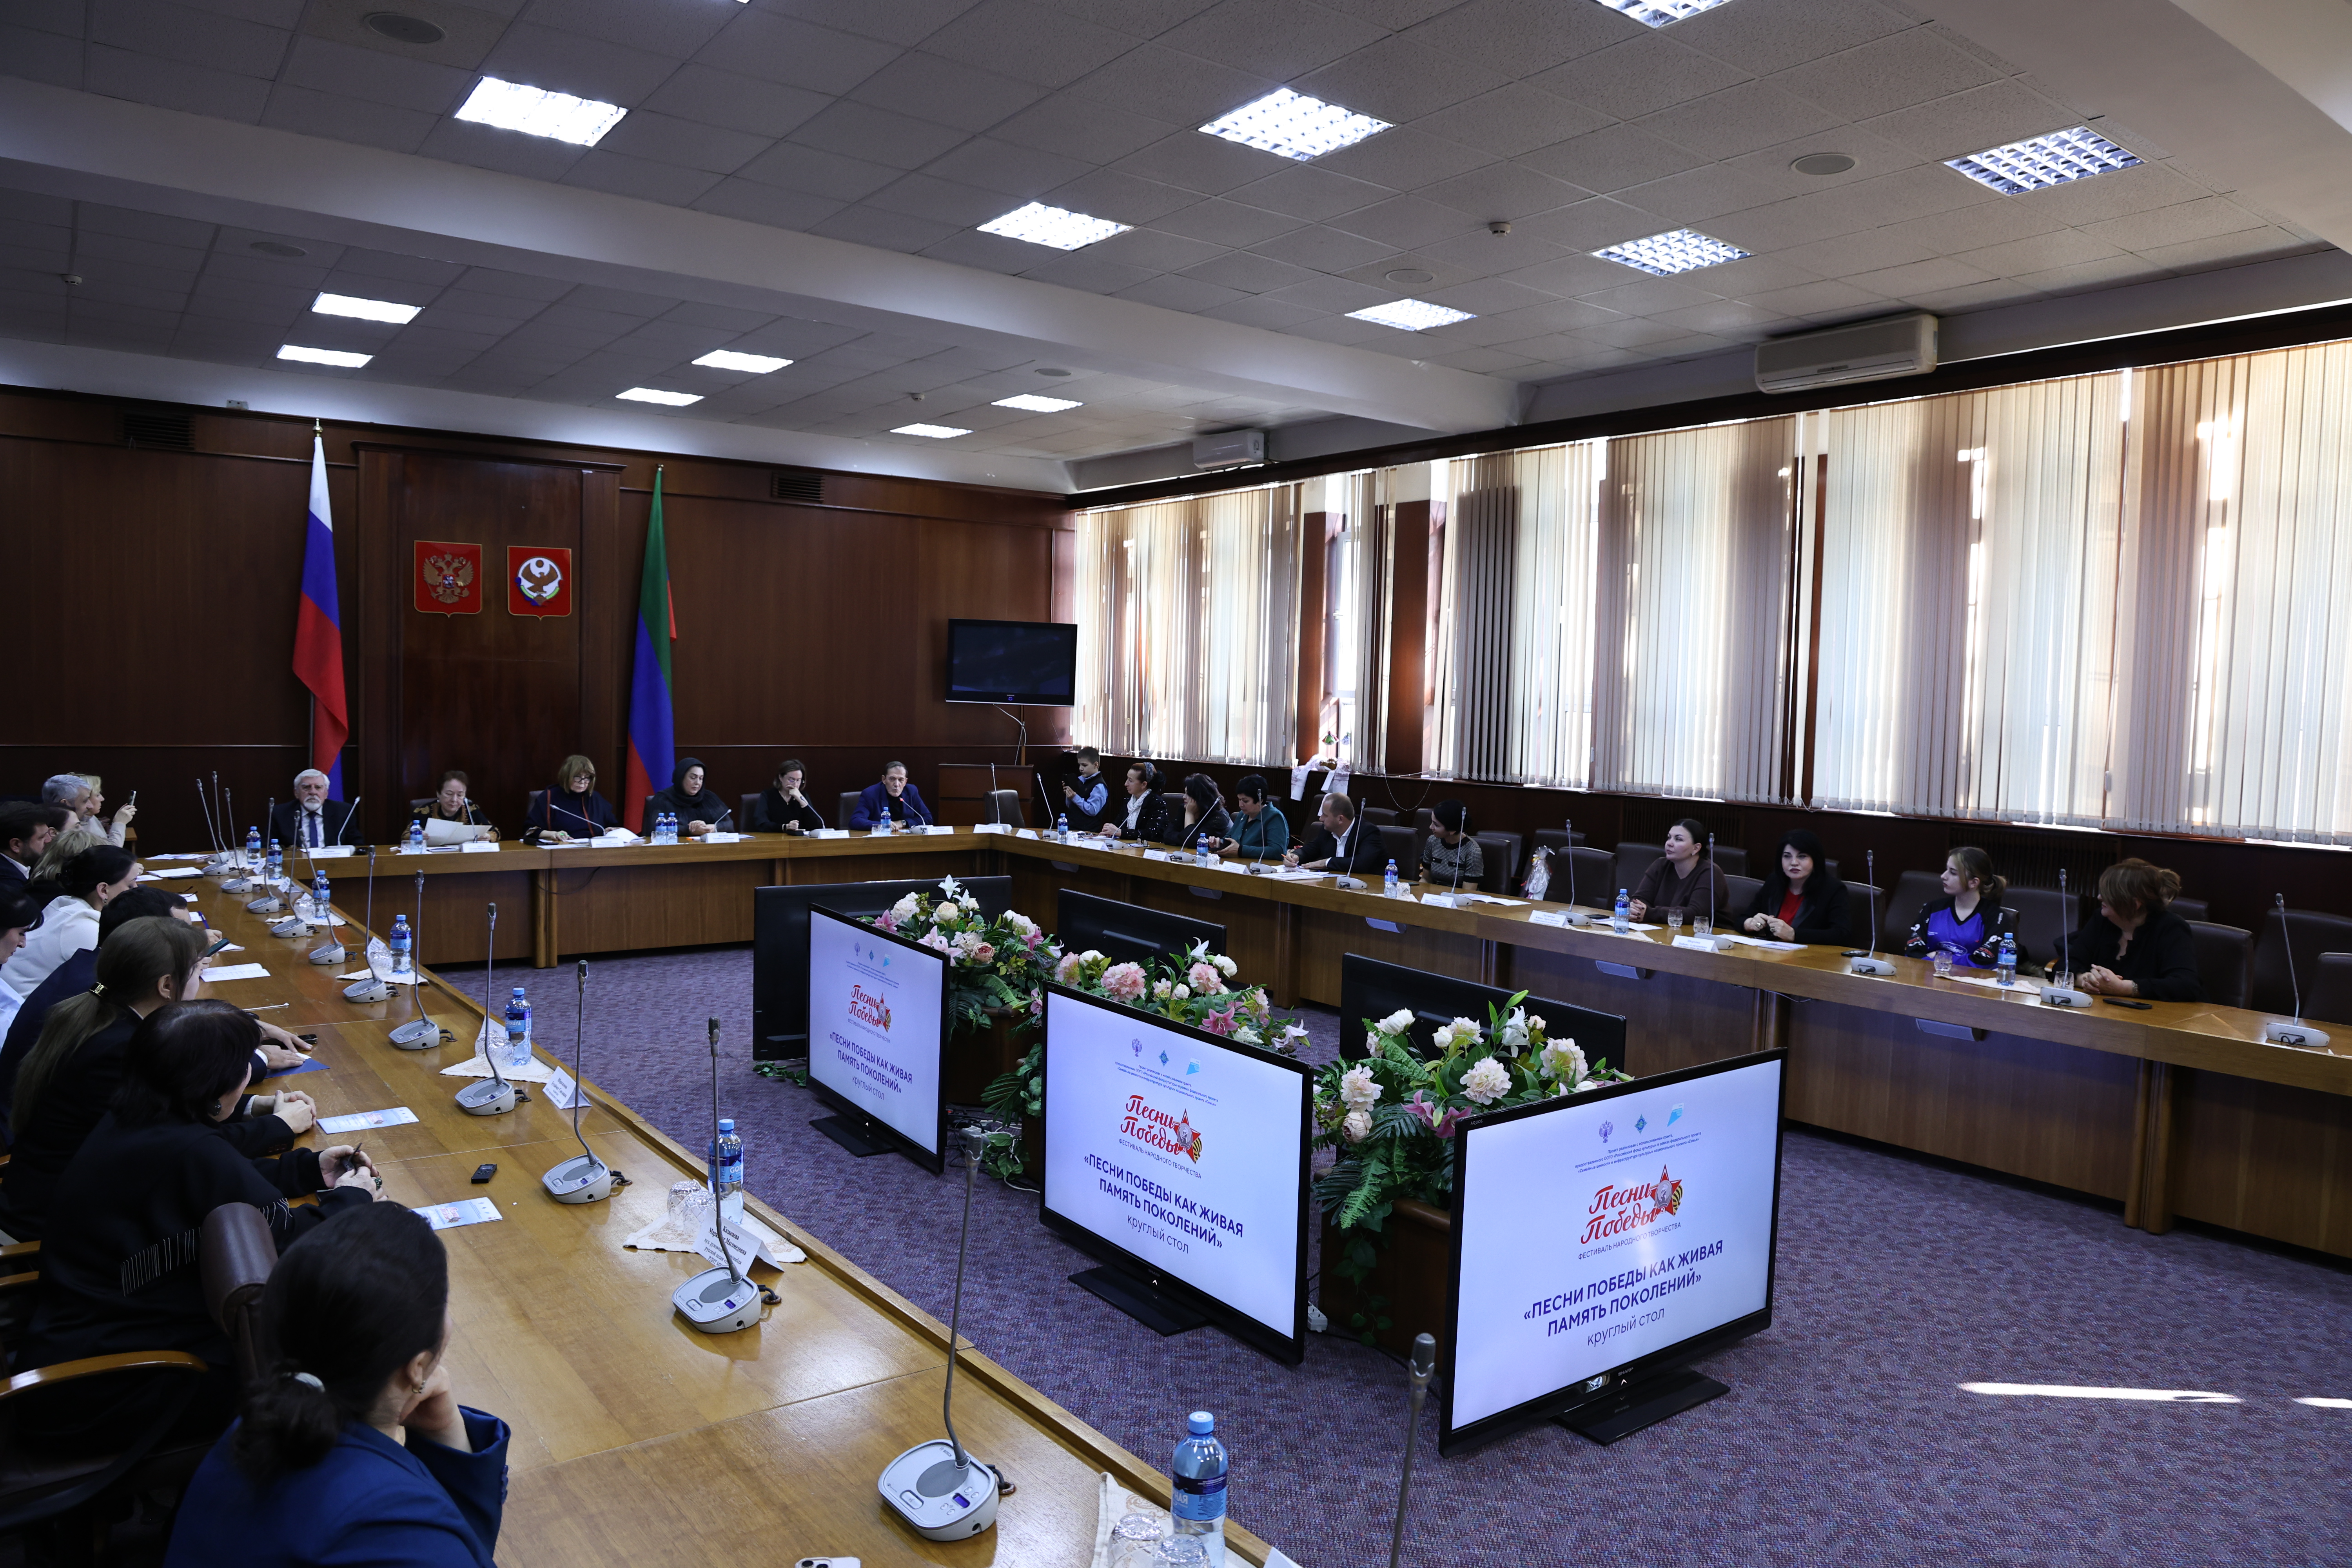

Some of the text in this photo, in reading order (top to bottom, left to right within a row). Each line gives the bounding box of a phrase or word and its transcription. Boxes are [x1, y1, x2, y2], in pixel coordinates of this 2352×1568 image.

[848, 1001, 880, 1027] Победы
[851, 984, 877, 1008] Песни
[829, 1032, 912, 1085] «ПЕСНИ ПОБЕДЫ КАК ЖИВАЯ
[838, 1049, 902, 1094] ПАМЯТЬ ПОКОЛЕНИЙ»
[852, 1076, 884, 1100] круглый стол
[1126, 1094, 1174, 1129] Песни
[1120, 1116, 1180, 1155] Победы
[1119, 1139, 1201, 1180] ФЕСТИВАЛЬ НАРОДНОГО ТВОРЧЕСТВА
[1084, 1154, 1243, 1238] «ПЕСНИ ПОБЕДЫ КАК ЖИВАЯ
[1100, 1178, 1222, 1248] ПАМЯТЬ ПОКОЛЕНИЙ»
[1589, 1183, 1652, 1214] Песни
[1127, 1215, 1189, 1254] круглый стол
[1578, 1222, 1681, 1260] ФЕСТИВАЛЬ НАРОДНОГО ТВОРЧЕСТВА
[1581, 1203, 1658, 1244] Победы
[704, 1247, 716, 1256] русской
[725, 1238, 747, 1256] Магомедовна
[1524, 1240, 1723, 1320] «ПЕСНИ ПОБЕДЫ КАК ЖИВАЯ
[1548, 1268, 1702, 1337] ПАМЯТЬ ПОКОЛЕНИЙ»
[1588, 1308, 1664, 1347] круглый стол
[1618, 1367, 1633, 1376] SHARP
